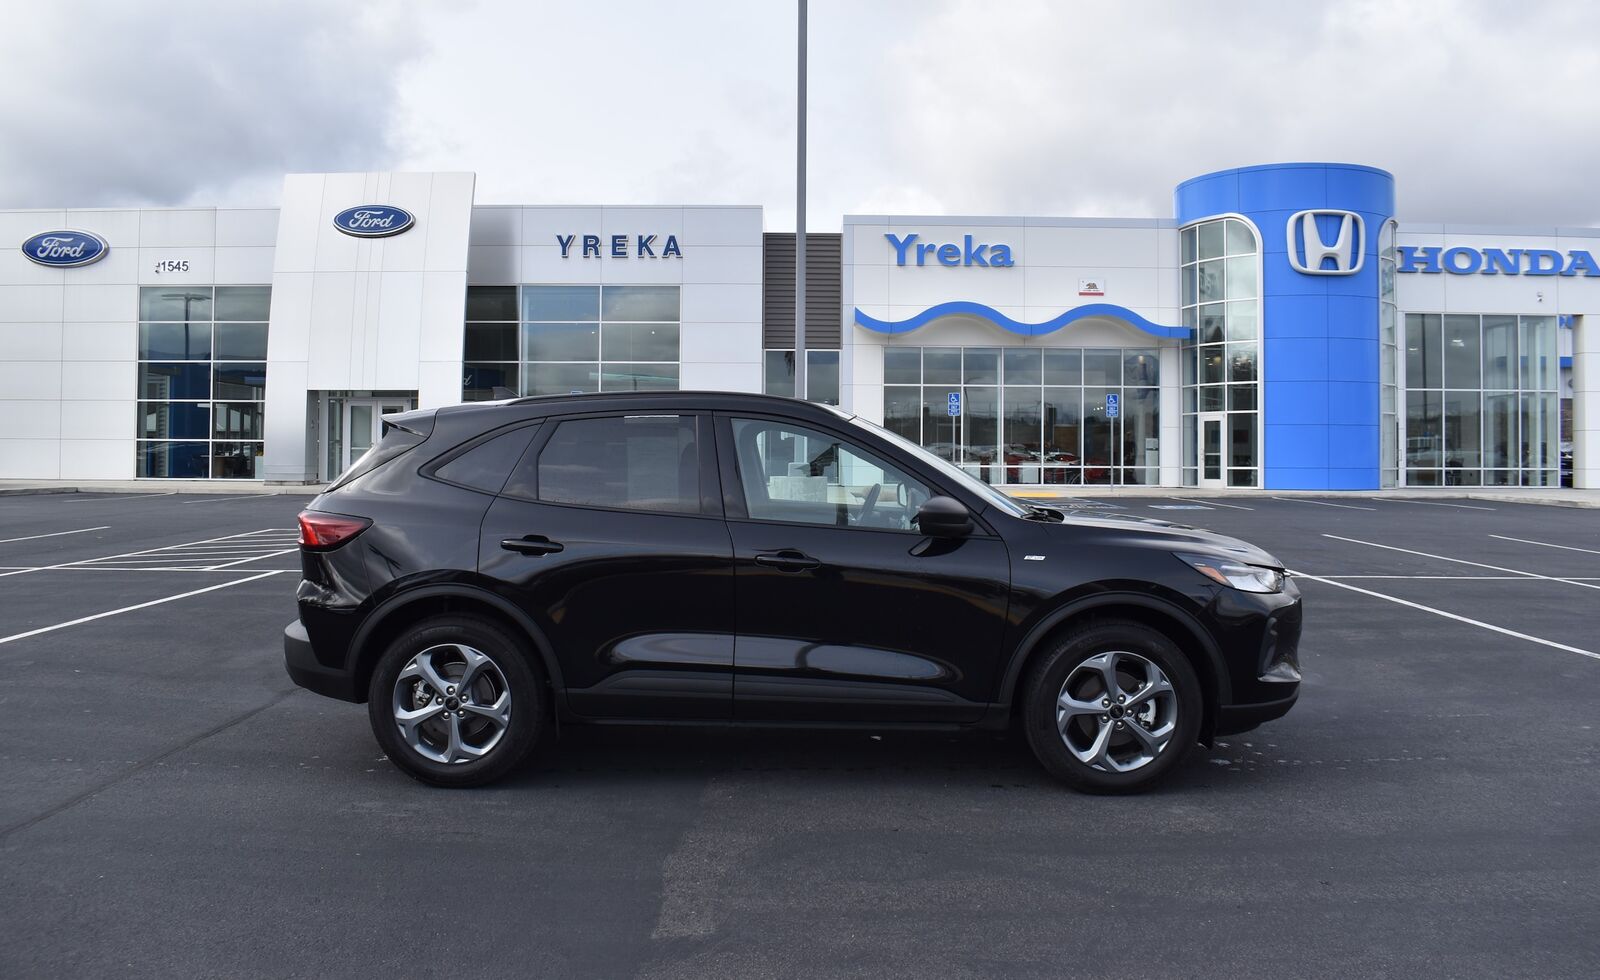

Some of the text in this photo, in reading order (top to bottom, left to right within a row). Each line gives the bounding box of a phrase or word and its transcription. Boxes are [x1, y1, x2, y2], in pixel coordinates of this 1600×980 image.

[345, 210, 395, 228] Ford
[36, 237, 86, 258] Ford
[557, 234, 683, 258] YREKA
[885, 233, 1014, 267] Yreka
[161, 260, 189, 271] 1545
[1397, 246, 1600, 277] HONDA
